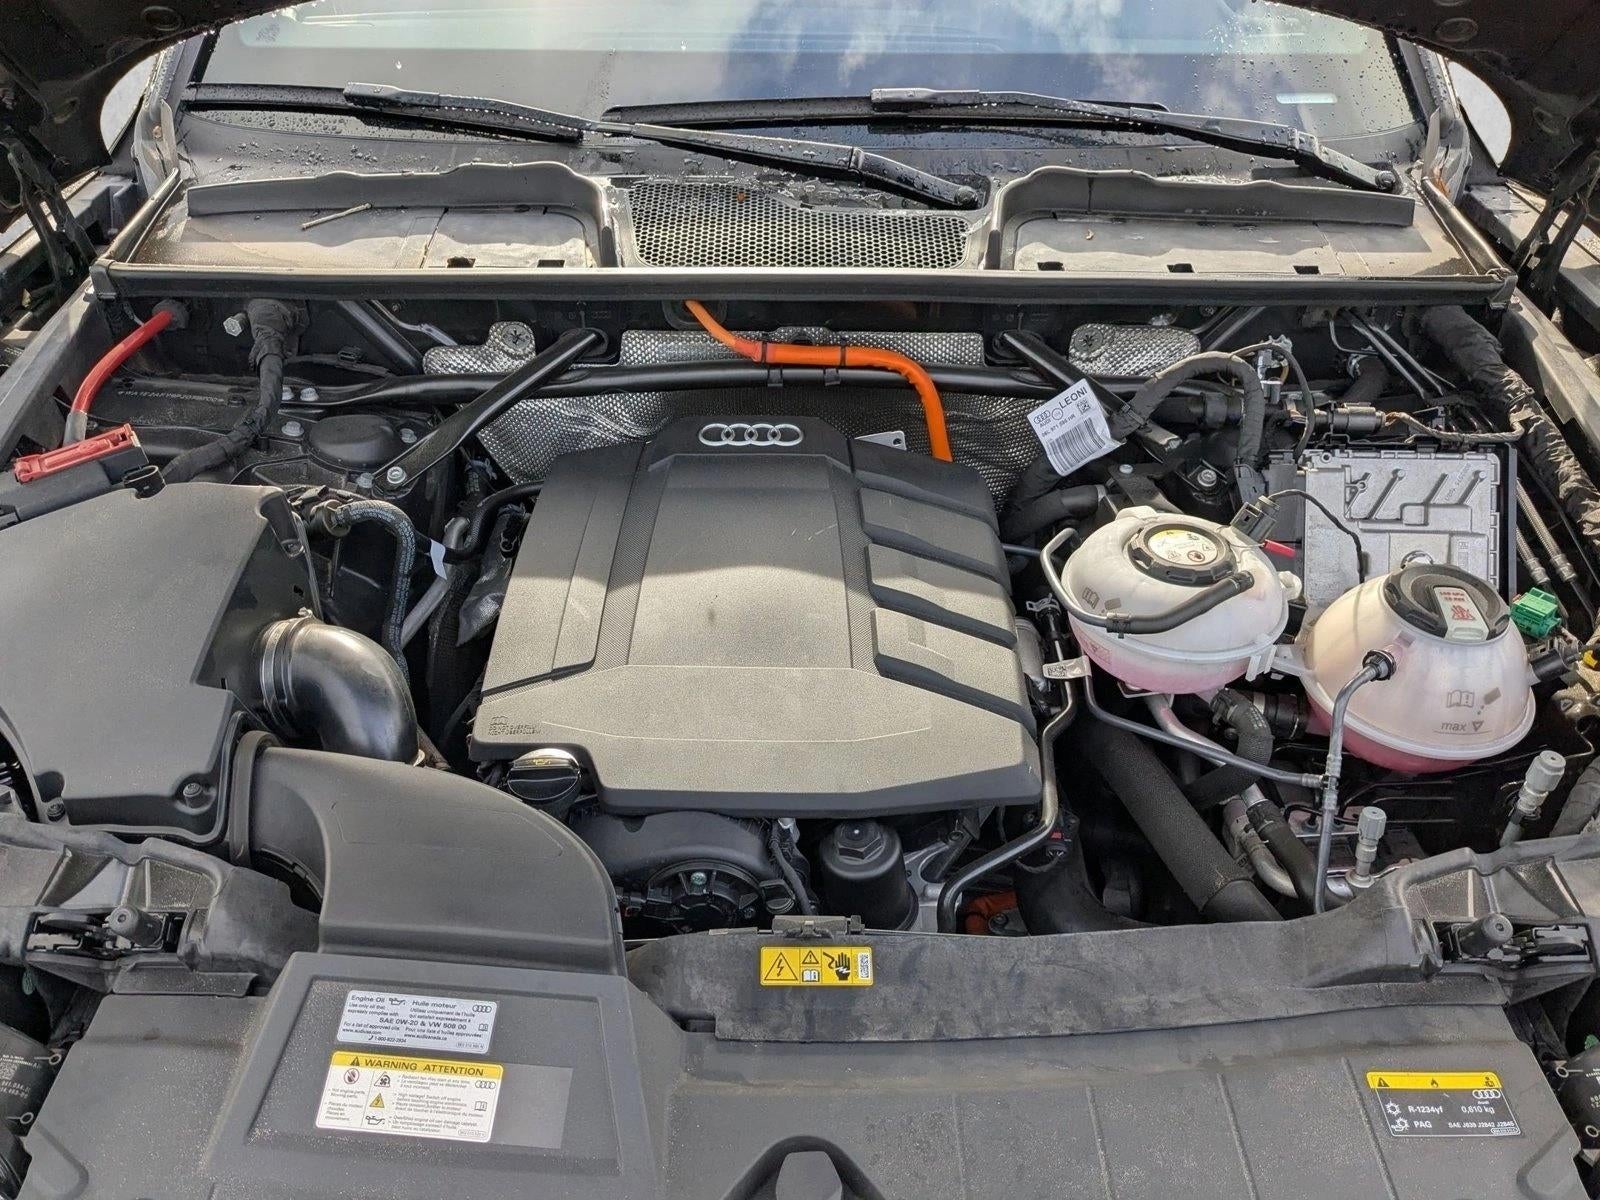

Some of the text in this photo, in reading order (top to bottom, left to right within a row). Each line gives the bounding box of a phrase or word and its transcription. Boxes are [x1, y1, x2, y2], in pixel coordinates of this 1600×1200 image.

[1059, 386, 1087, 409] LEONI
[1441, 722, 1467, 731] max
[351, 994, 385, 1004] Engine Oil
[430, 1001, 456, 1009] moteur
[379, 1016, 418, 1026] SAE 0W-20
[365, 1059, 484, 1076] WARNING ATTENTION
[1407, 1105, 1444, 1115] R-1234yf
[1484, 1105, 1495, 1114] kg
[1413, 1121, 1432, 1129] PAG
